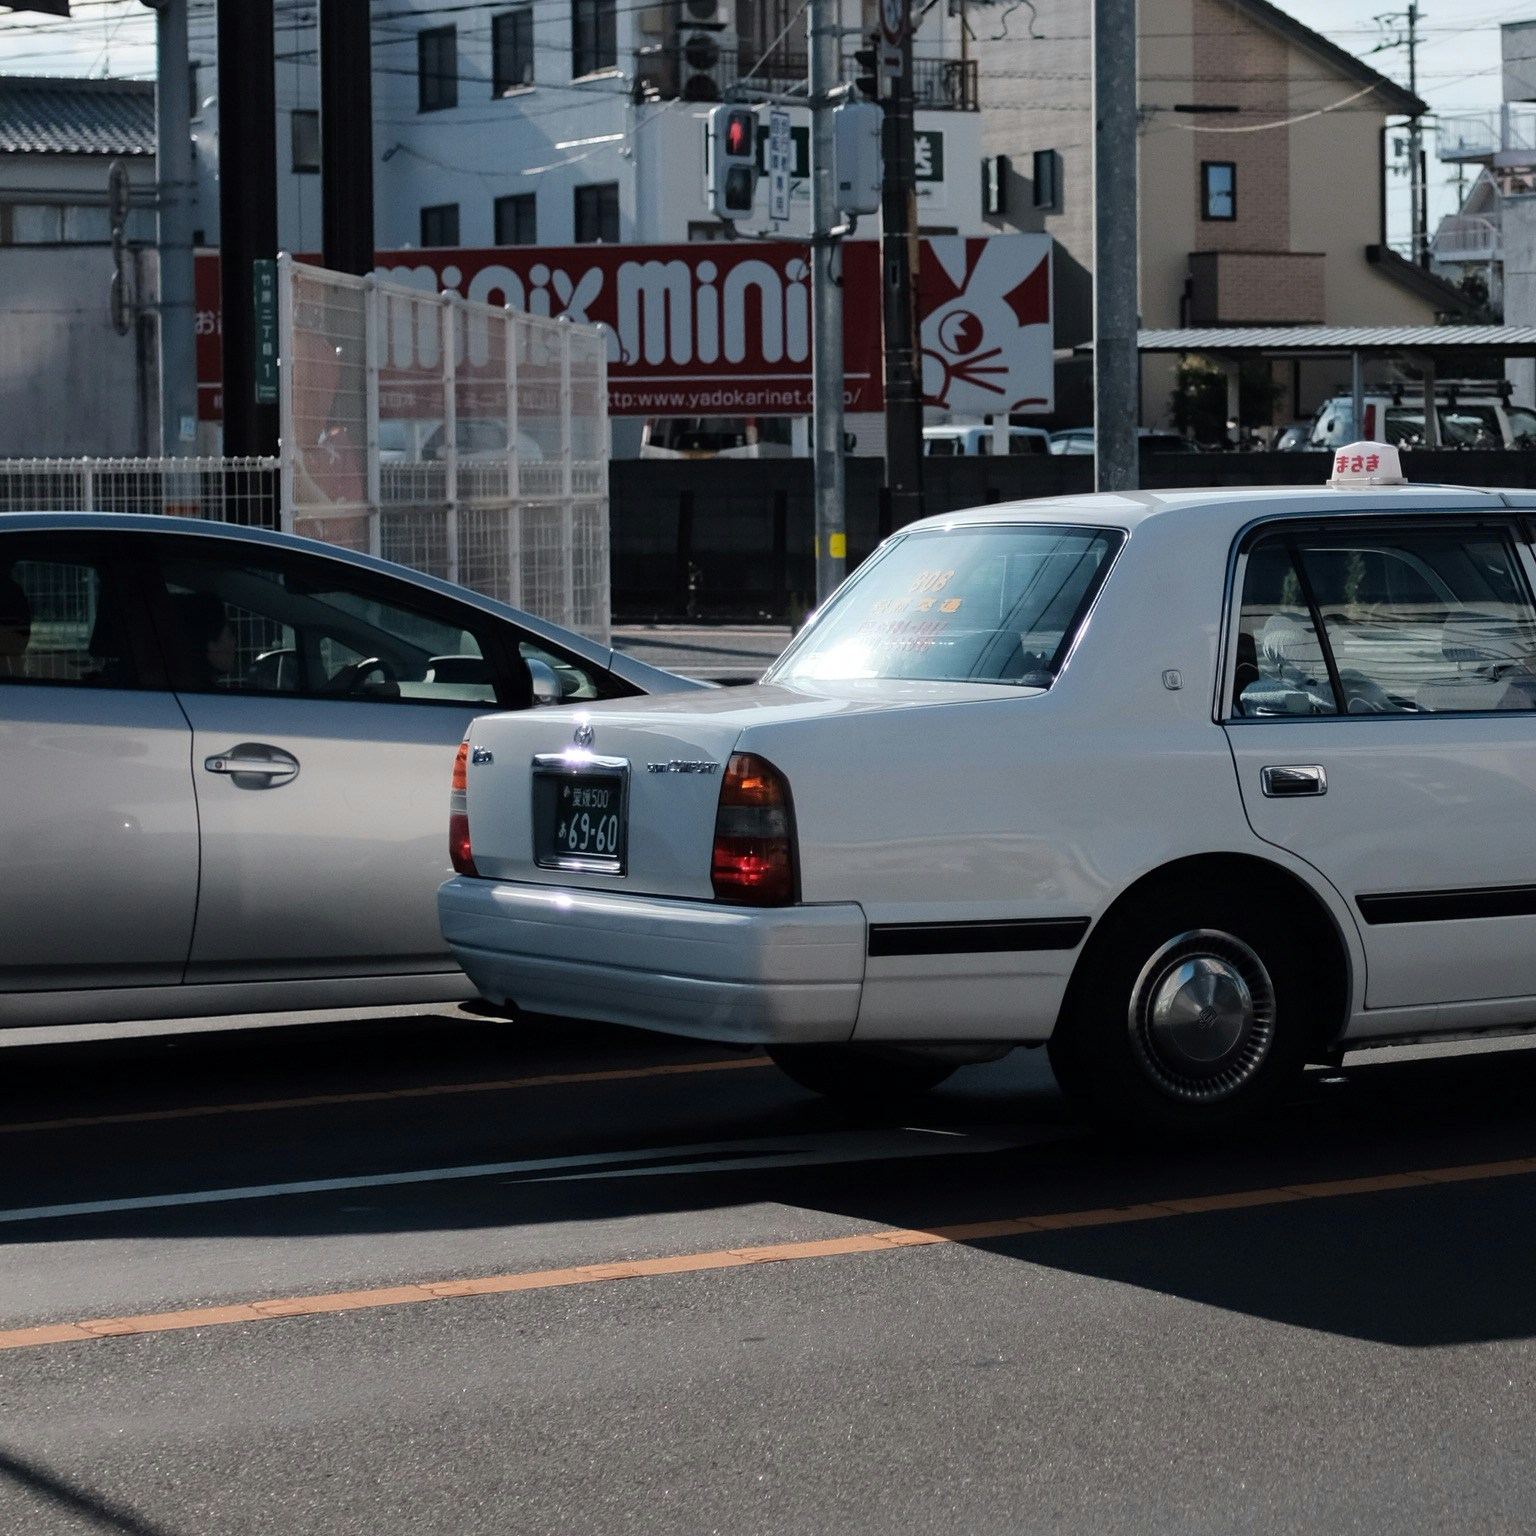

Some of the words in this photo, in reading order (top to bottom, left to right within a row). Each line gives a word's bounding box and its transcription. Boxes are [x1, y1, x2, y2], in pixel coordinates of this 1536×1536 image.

[616, 257, 813, 367] mini
[1336, 453, 1380, 474] まさき
[568, 812, 618, 853] 69-60
